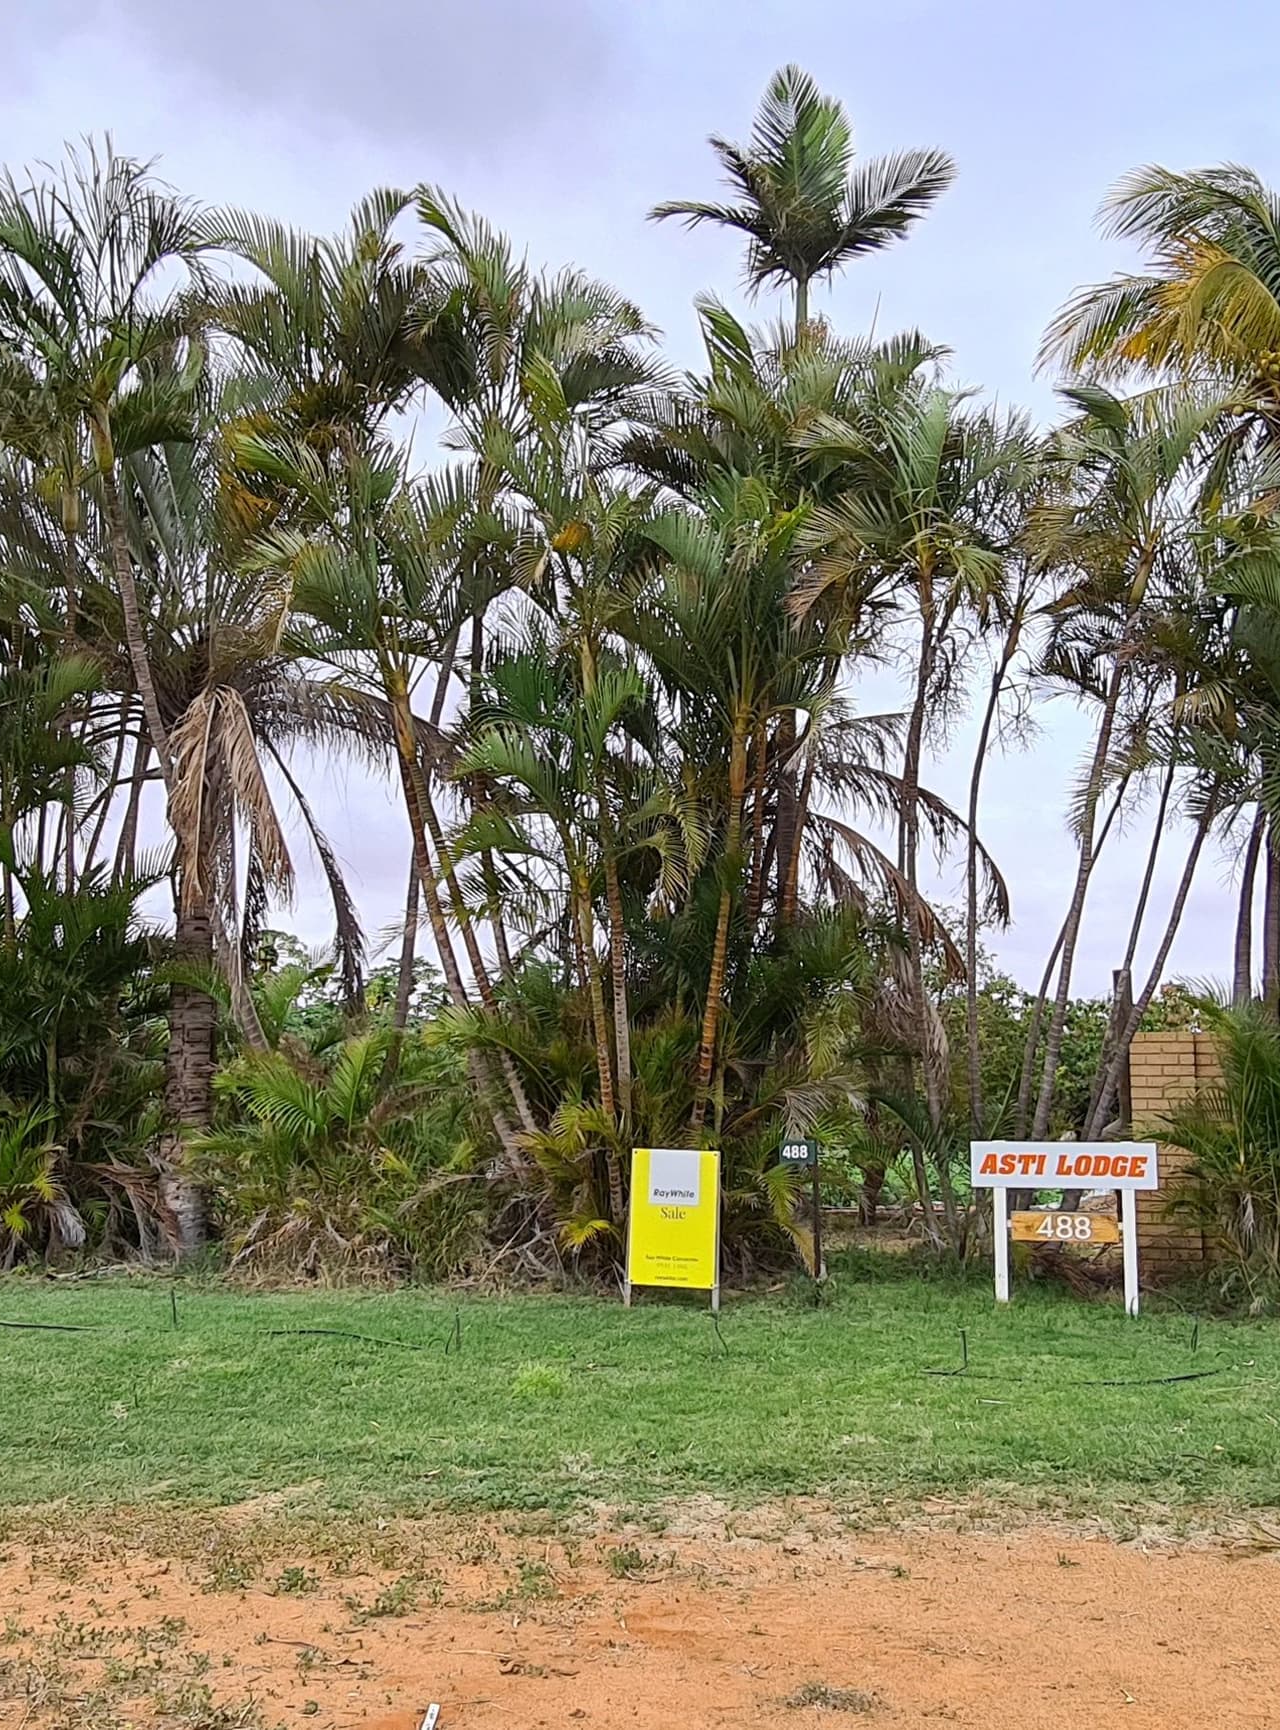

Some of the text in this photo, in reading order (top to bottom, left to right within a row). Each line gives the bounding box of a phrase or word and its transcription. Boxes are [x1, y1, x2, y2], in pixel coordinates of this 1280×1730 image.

[782, 1145, 809, 1159] 488
[979, 1153, 1148, 1178] ASTI LODGE
[660, 1206, 686, 1220] Sale
[1036, 1215, 1091, 1239] 488
